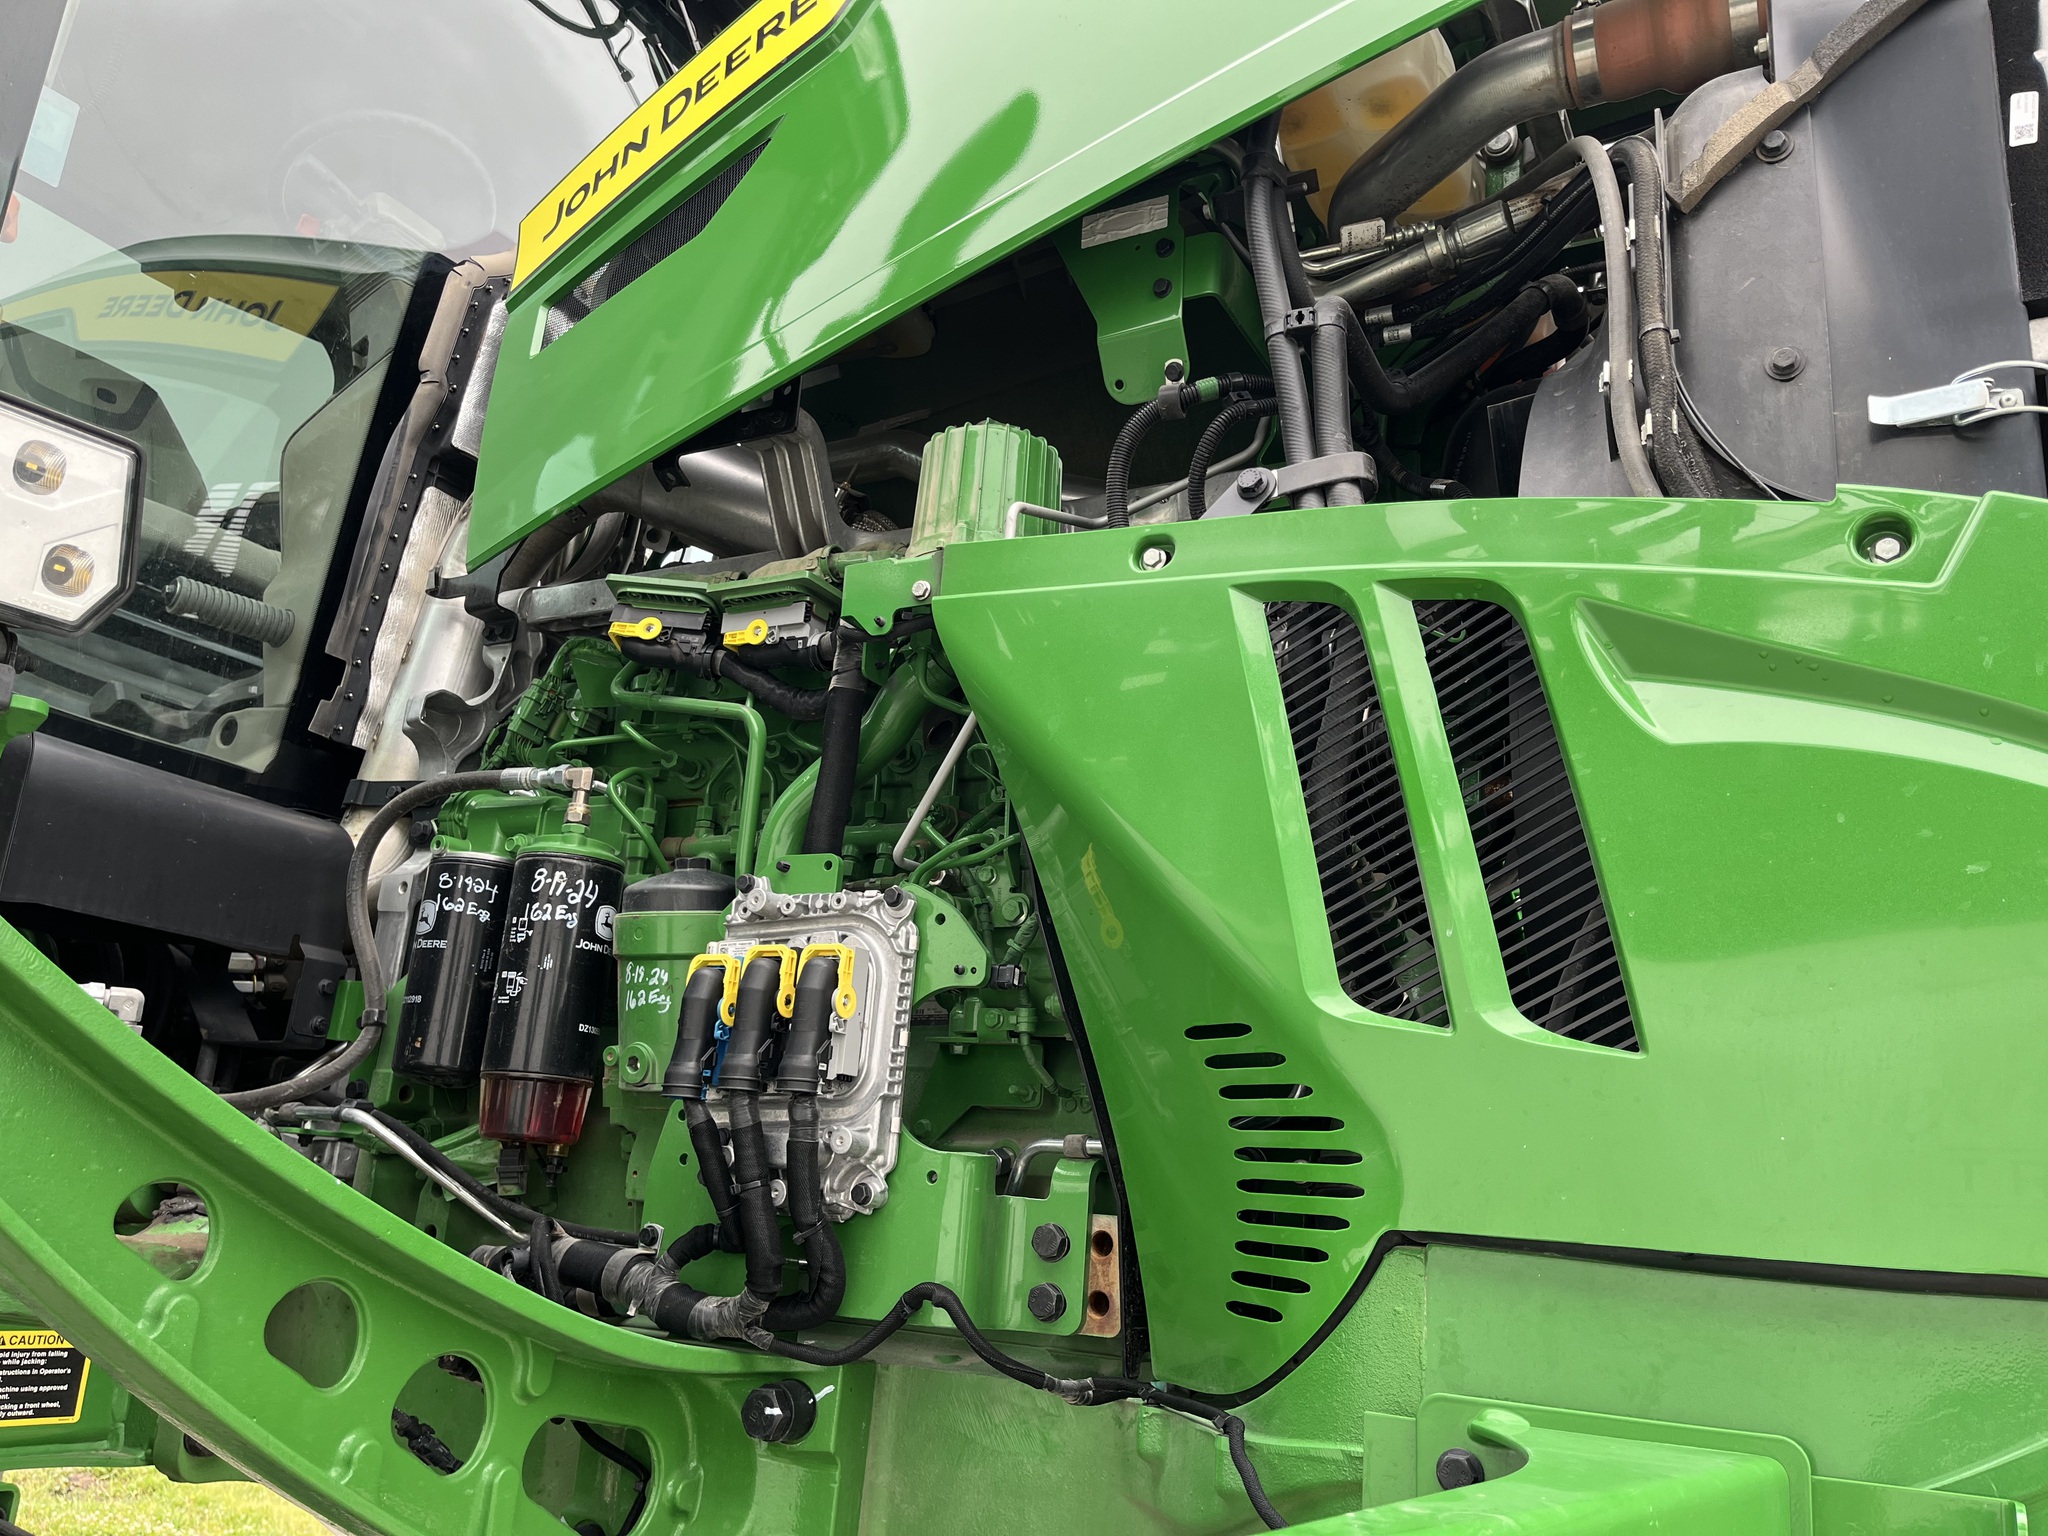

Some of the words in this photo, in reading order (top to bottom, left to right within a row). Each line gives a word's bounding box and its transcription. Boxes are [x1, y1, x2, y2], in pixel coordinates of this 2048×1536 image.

[542, 124, 650, 243] JOHN
[660, 0, 818, 135] DEERE
[417, 939, 448, 949] DEERE
[575, 938, 603, 953] JOHN
[10, 1335, 64, 1345] CAUTION
[11, 1351, 30, 1359] injury
[48, 1350, 68, 1358] falling
[21, 1358, 47, 1366] jacking:
[20, 1385, 38, 1393] using
[39, 1384, 68, 1392] approved
